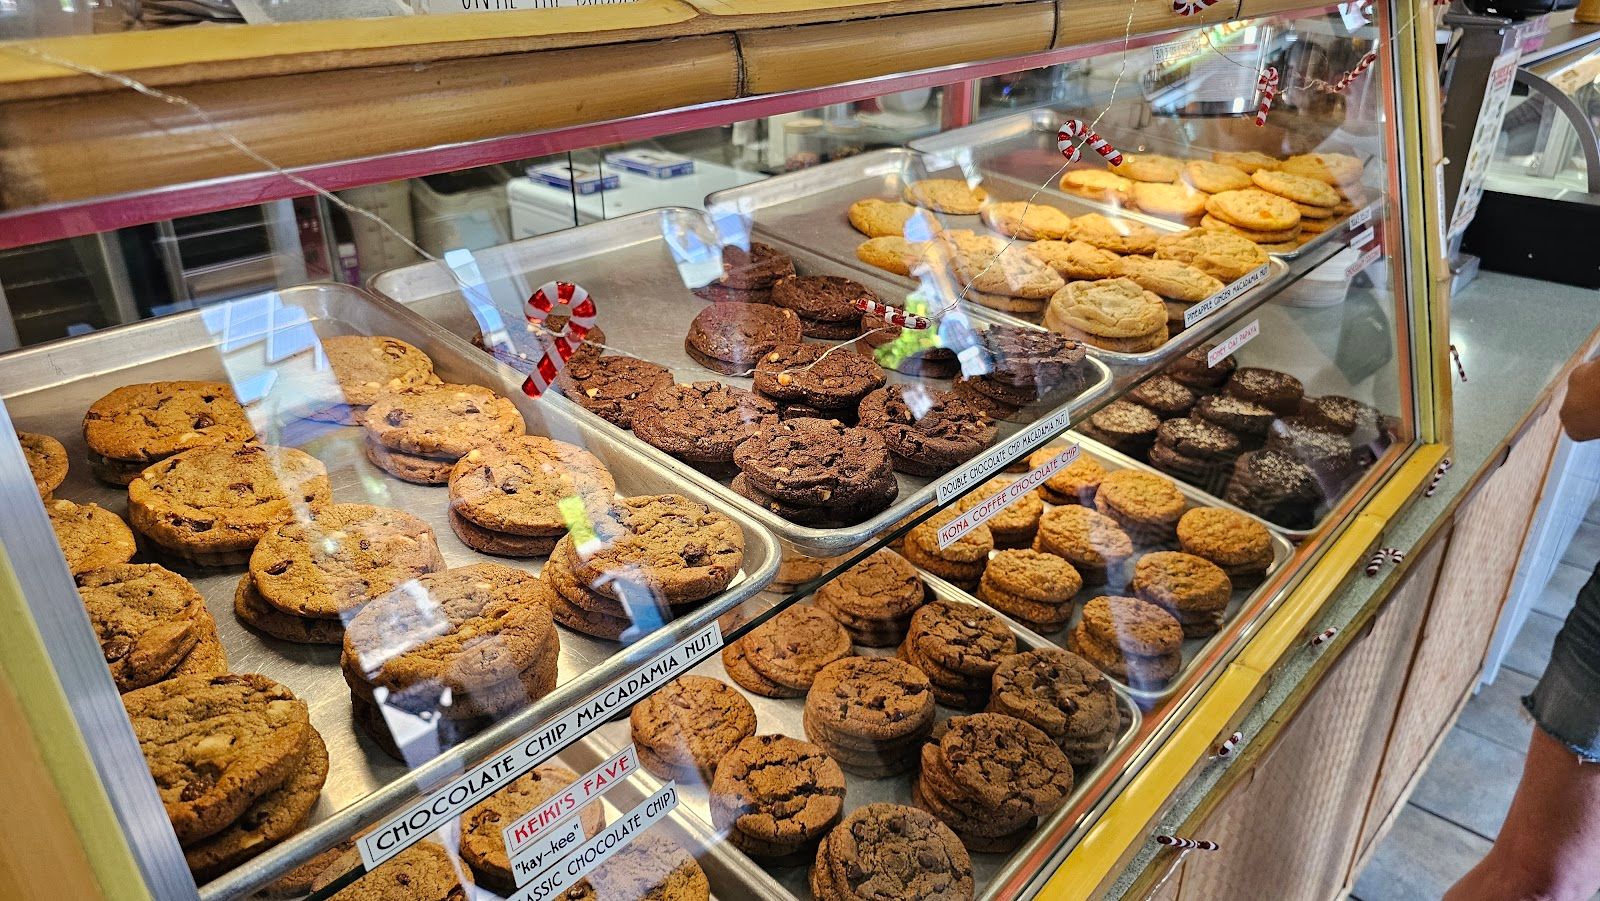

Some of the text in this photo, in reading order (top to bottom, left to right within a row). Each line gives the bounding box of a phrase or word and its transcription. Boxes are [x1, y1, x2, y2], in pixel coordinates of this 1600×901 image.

[1213, 289, 1231, 306] GINGER
[1232, 273, 1259, 295] MACADAMIA
[1259, 266, 1269, 279] NUT
[942, 413, 1066, 497] DOUBLE CHOCOLATE CHIP MACADAMIA NUT
[942, 445, 1078, 540] KONA COFFEE CHOCOLATE CHIP
[376, 631, 715, 851] CHOCOLATE CHIP MACADAMIA NUT
[514, 755, 630, 844] KEIKI'S FAVE
[567, 812, 642, 874] CHOCOLATE
